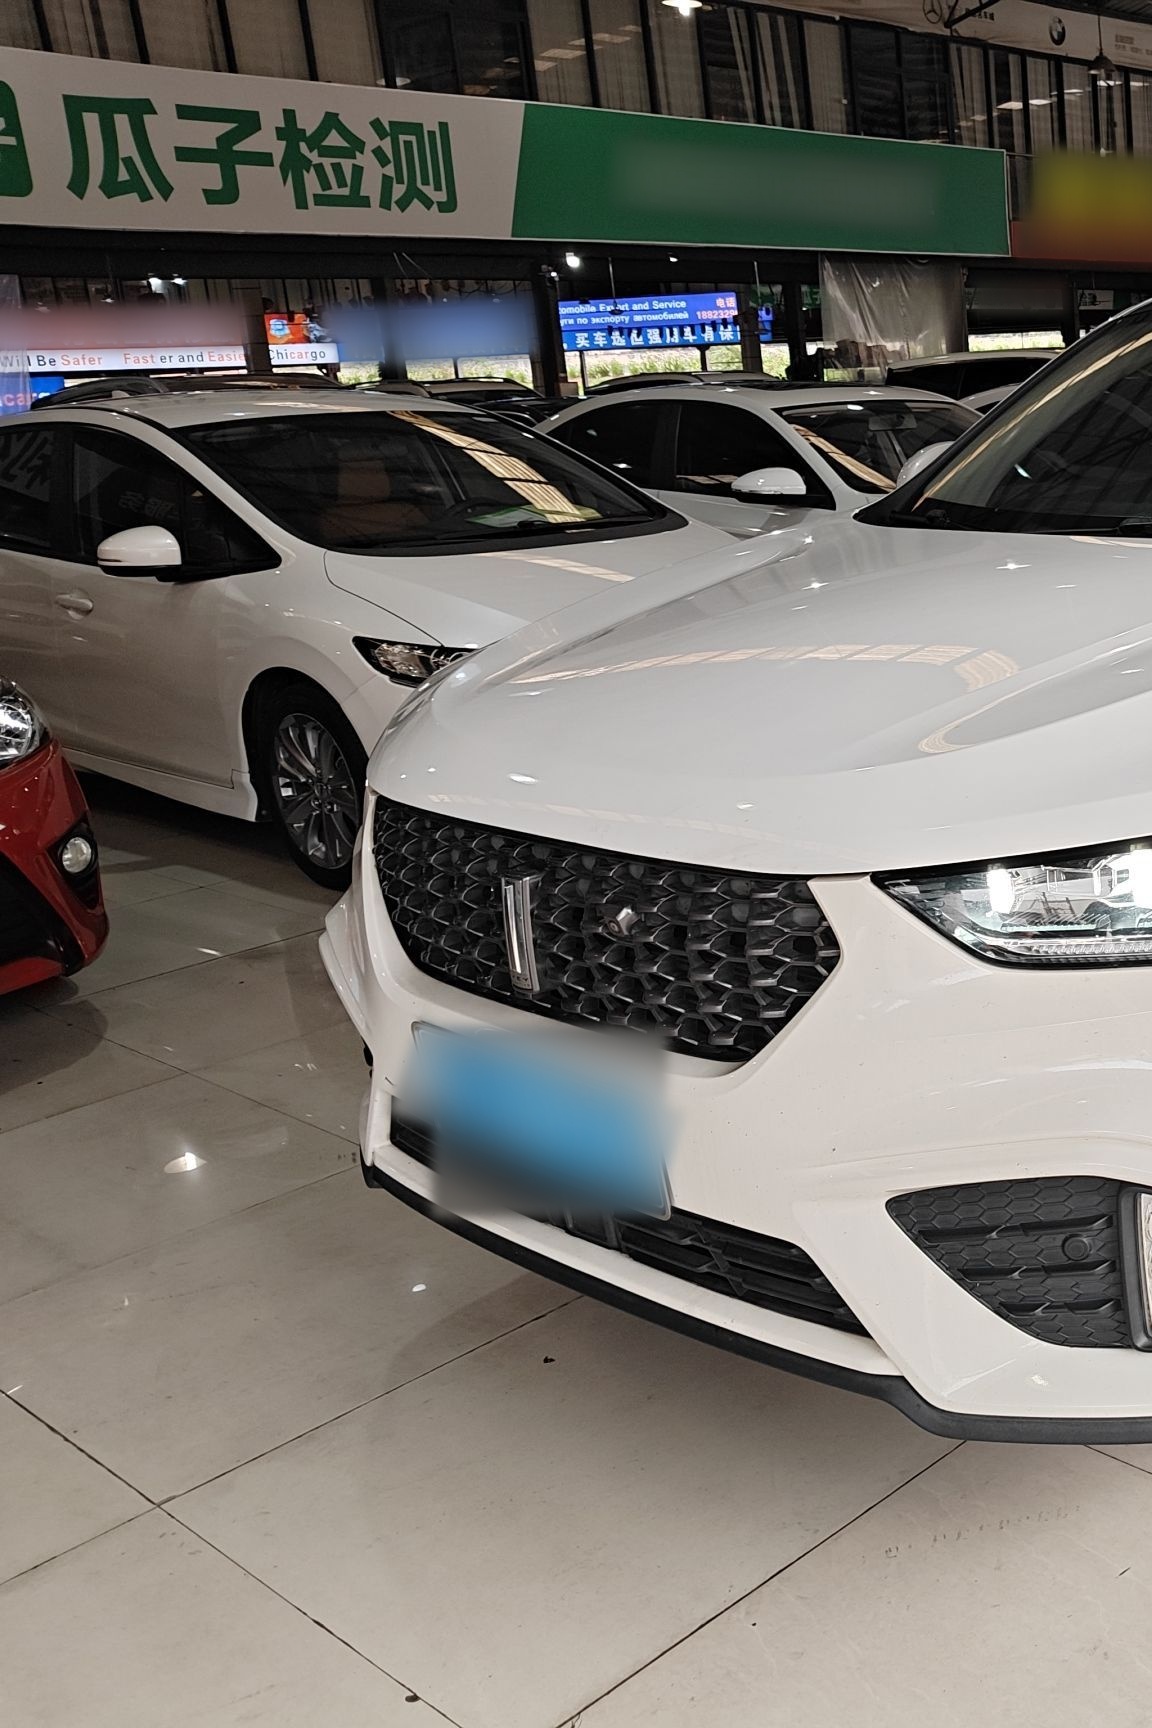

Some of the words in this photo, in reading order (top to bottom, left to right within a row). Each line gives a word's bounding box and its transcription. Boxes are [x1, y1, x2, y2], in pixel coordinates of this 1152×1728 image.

[62, 94, 458, 213] 瓜子检测
[632, 301, 650, 311] and
[653, 300, 687, 310] Service
[577, 317, 589, 325] по
[591, 315, 630, 325] экспорту
[633, 311, 689, 322] автомобилей
[36, 354, 57, 367] Be
[61, 353, 103, 366] Safer
[178, 351, 204, 363] and
